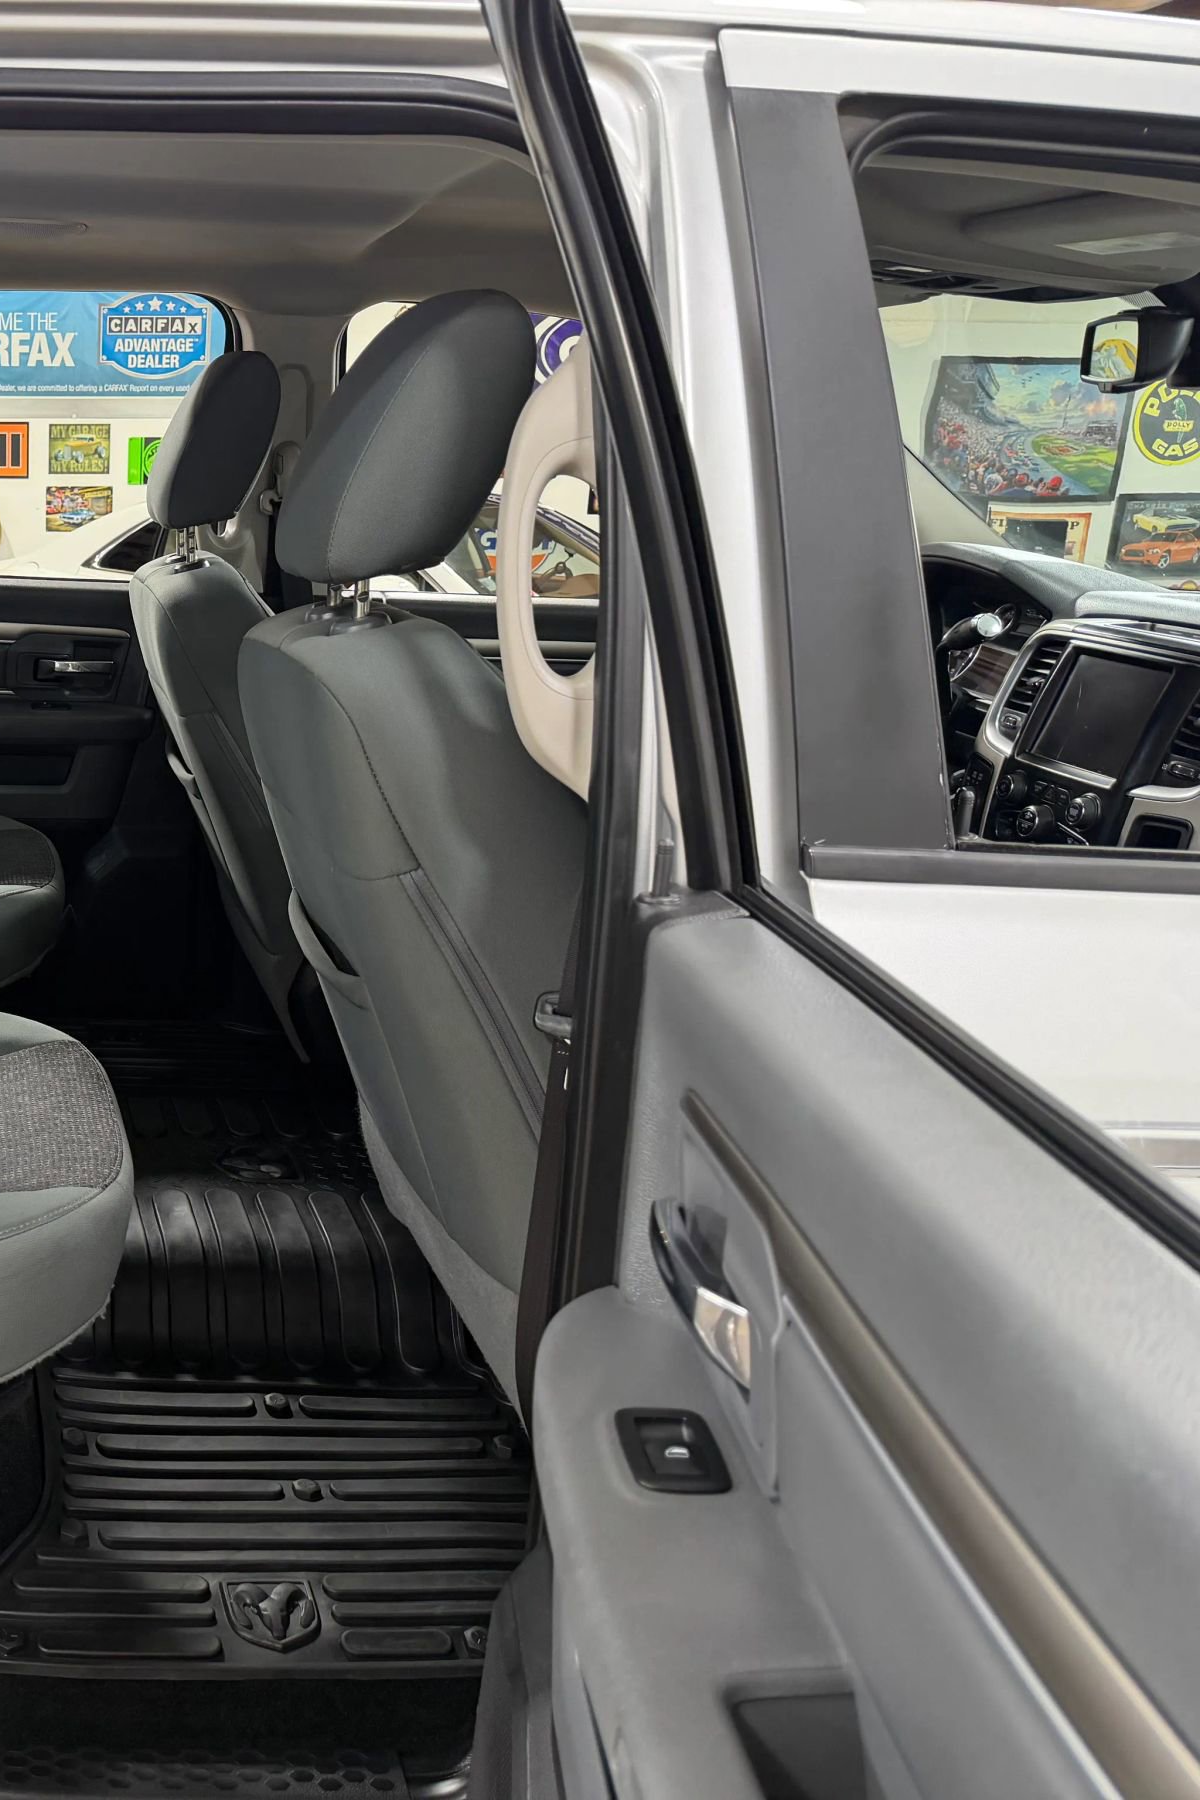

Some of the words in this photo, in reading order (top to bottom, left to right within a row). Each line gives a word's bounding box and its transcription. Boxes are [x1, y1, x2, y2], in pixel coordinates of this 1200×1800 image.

[27, 312, 58, 331] THE
[110, 318, 199, 334] CARFAX
[114, 338, 195, 353] ADVANTAGE
[127, 354, 180, 368] DEALER
[51, 425, 67, 438] MY
[1152, 437, 1199, 457] GAS
[51, 460, 67, 472] MY
[70, 459, 108, 472] RULES!
